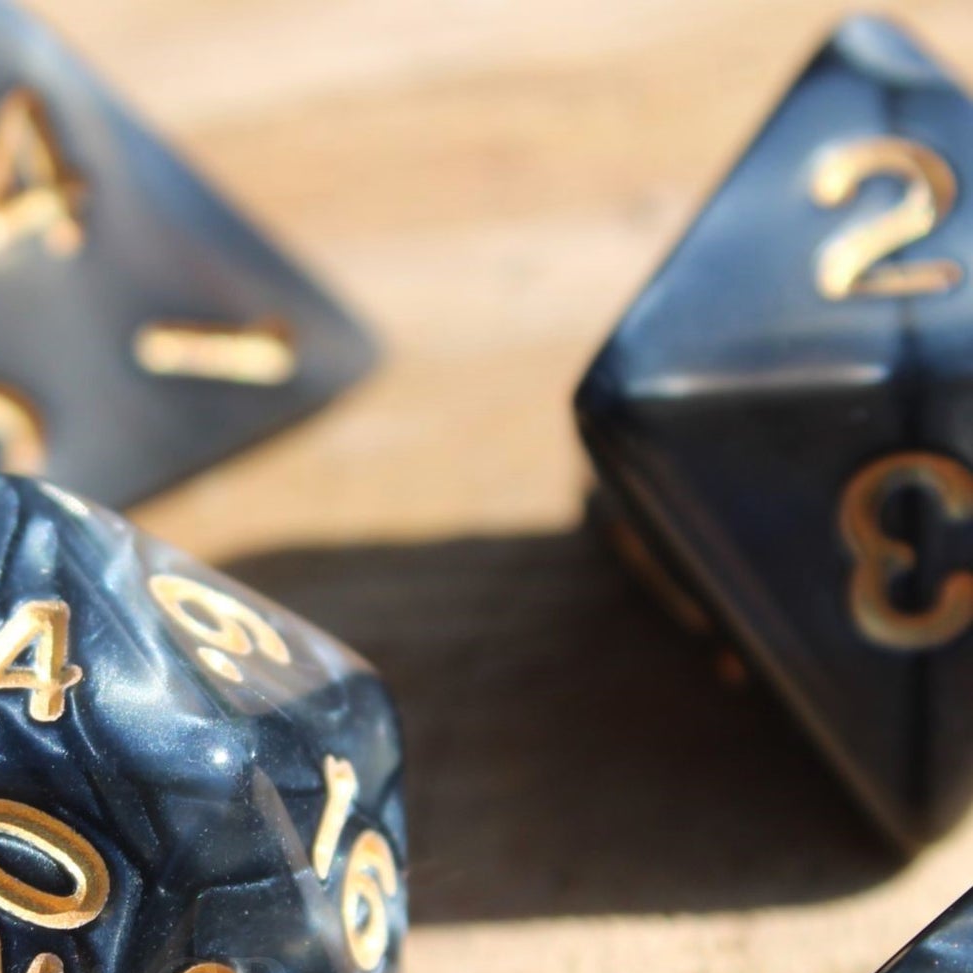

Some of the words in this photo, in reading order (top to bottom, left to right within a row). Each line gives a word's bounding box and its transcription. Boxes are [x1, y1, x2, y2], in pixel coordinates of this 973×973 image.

[811, 136, 963, 300] 2
[133, 320, 293, 386] 1
[839, 452, 973, 650] 3
[311, 755, 399, 972] 16
